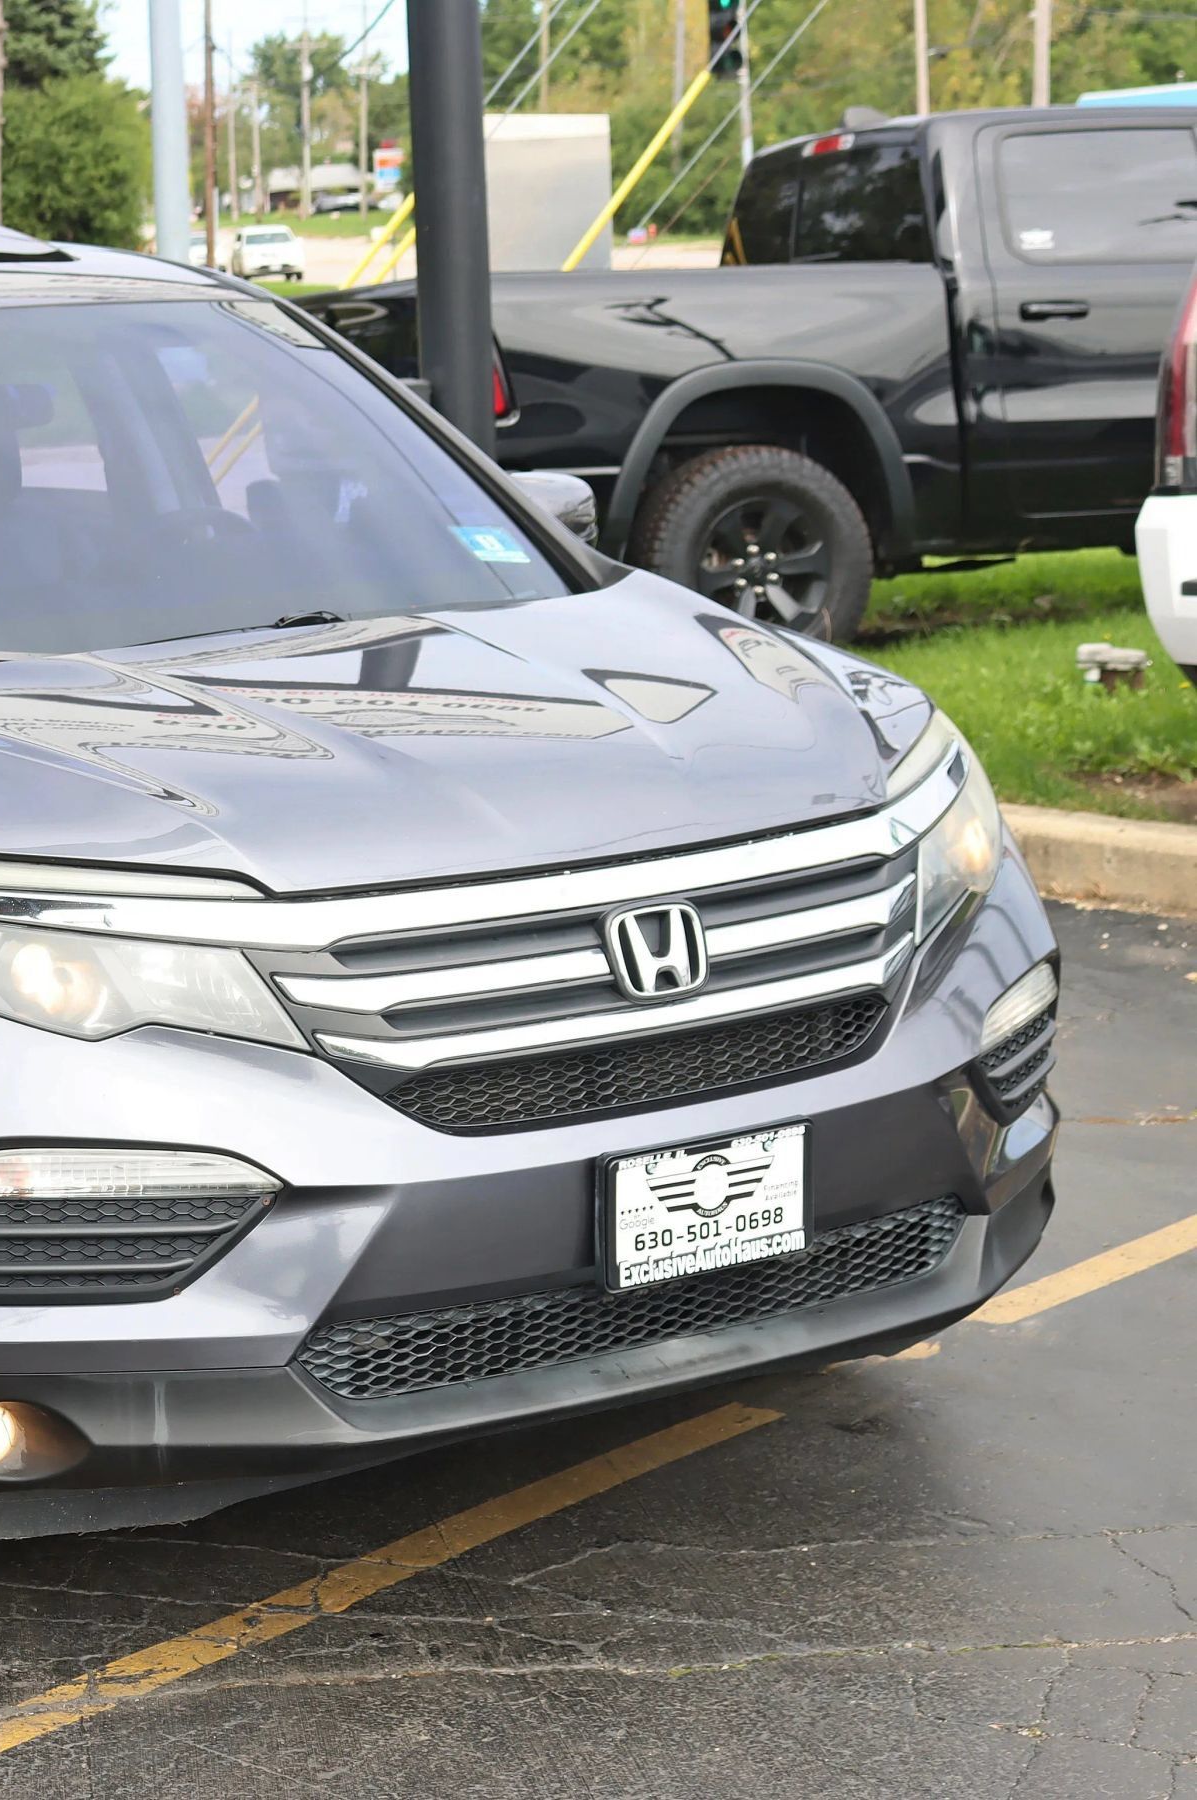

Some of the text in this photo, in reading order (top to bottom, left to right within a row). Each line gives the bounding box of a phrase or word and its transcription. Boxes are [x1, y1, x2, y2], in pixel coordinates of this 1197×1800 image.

[619, 1217, 656, 1231] Google
[634, 1206, 784, 1251] 630-501-0698
[619, 1230, 806, 1288] ExclusiveAutoHaus.com
